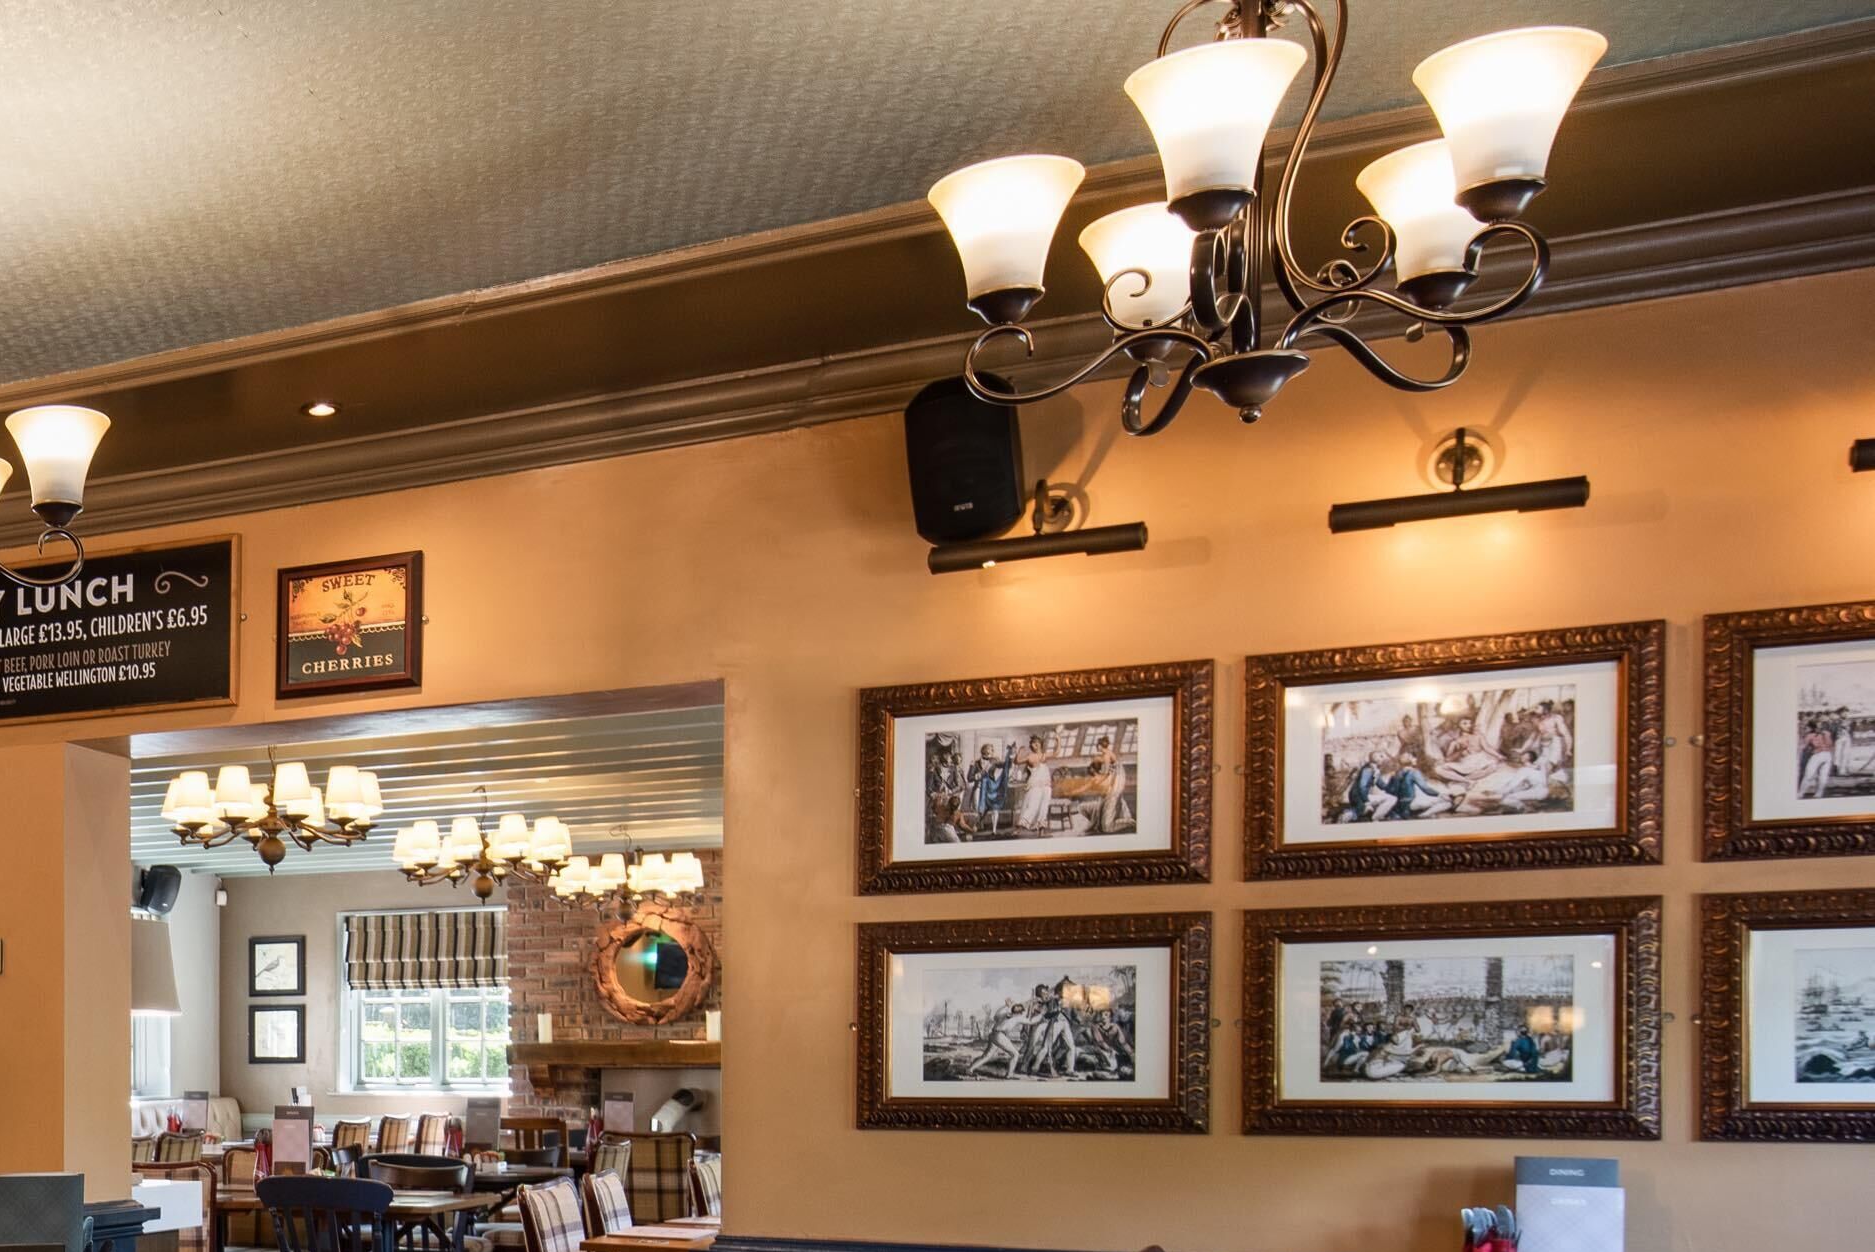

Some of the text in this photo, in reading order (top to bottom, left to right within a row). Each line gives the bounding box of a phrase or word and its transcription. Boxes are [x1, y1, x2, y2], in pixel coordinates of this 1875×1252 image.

[17, 573, 134, 616] LUNCH
[322, 574, 375, 592] SWEET
[0, 624, 35, 648] LARGE
[38, 619, 87, 644] £13.95,
[90, 610, 164, 637] CHILDREN'S
[166, 604, 208, 629] £6.95
[29, 653, 55, 672] PORK
[57, 651, 80, 669] LOIN
[82, 649, 96, 665] OR
[98, 645, 130, 663] ROAST
[132, 640, 171, 661] TURKEY
[301, 653, 394, 675] CHERRIES
[2, 671, 54, 692] VEGETABLE
[55, 665, 116, 687] WELLINGTON
[118, 661, 156, 681] £10.95
[1549, 1168, 1585, 1177] DINING
